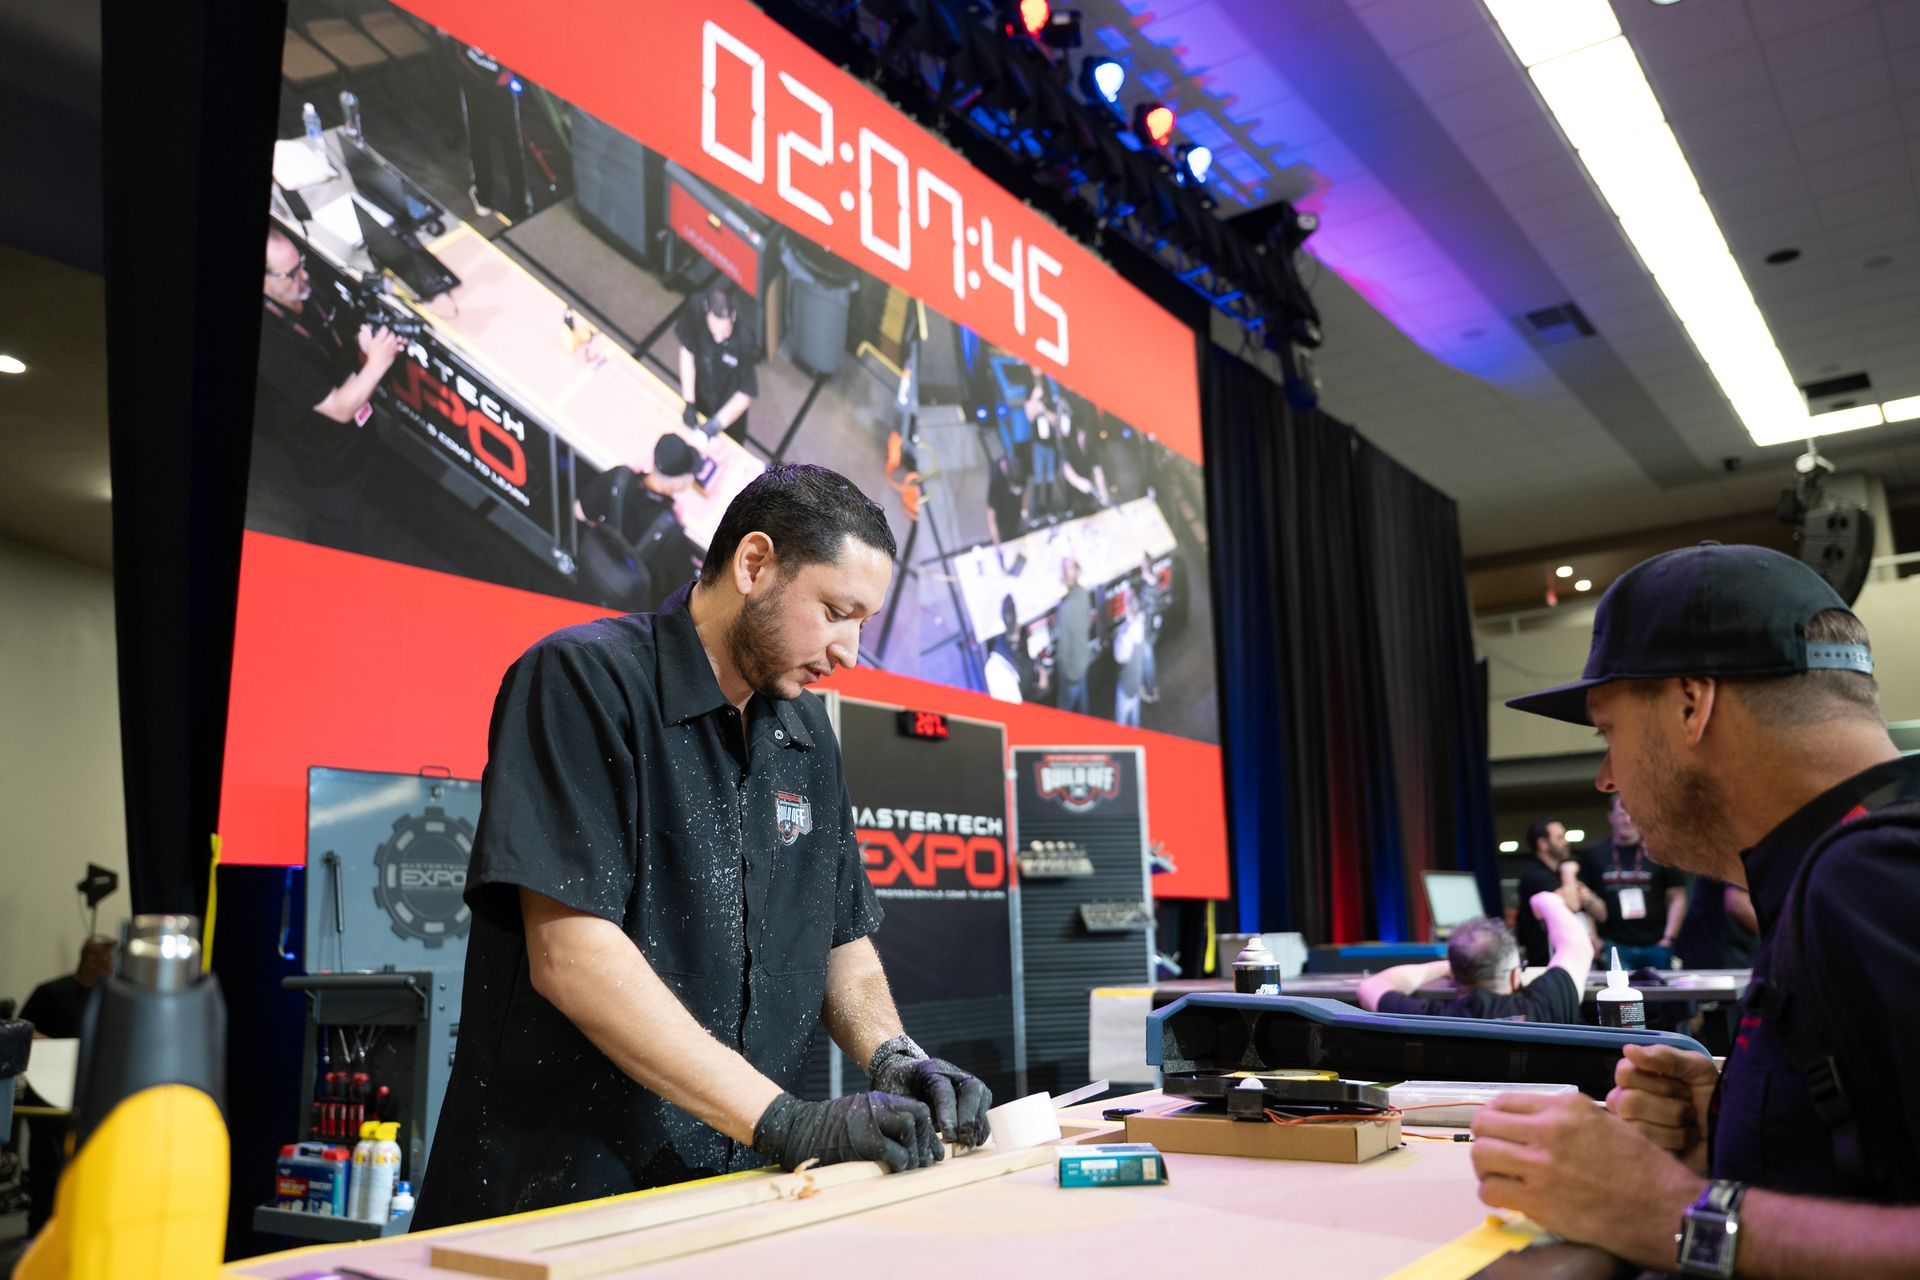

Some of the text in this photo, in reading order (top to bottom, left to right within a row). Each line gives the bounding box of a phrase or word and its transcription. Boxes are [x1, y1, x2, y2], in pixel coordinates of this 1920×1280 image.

[702, 20, 1070, 367] 02:07:45
[401, 869, 467, 886] EXPO
[855, 827, 1005, 889] EXPO
